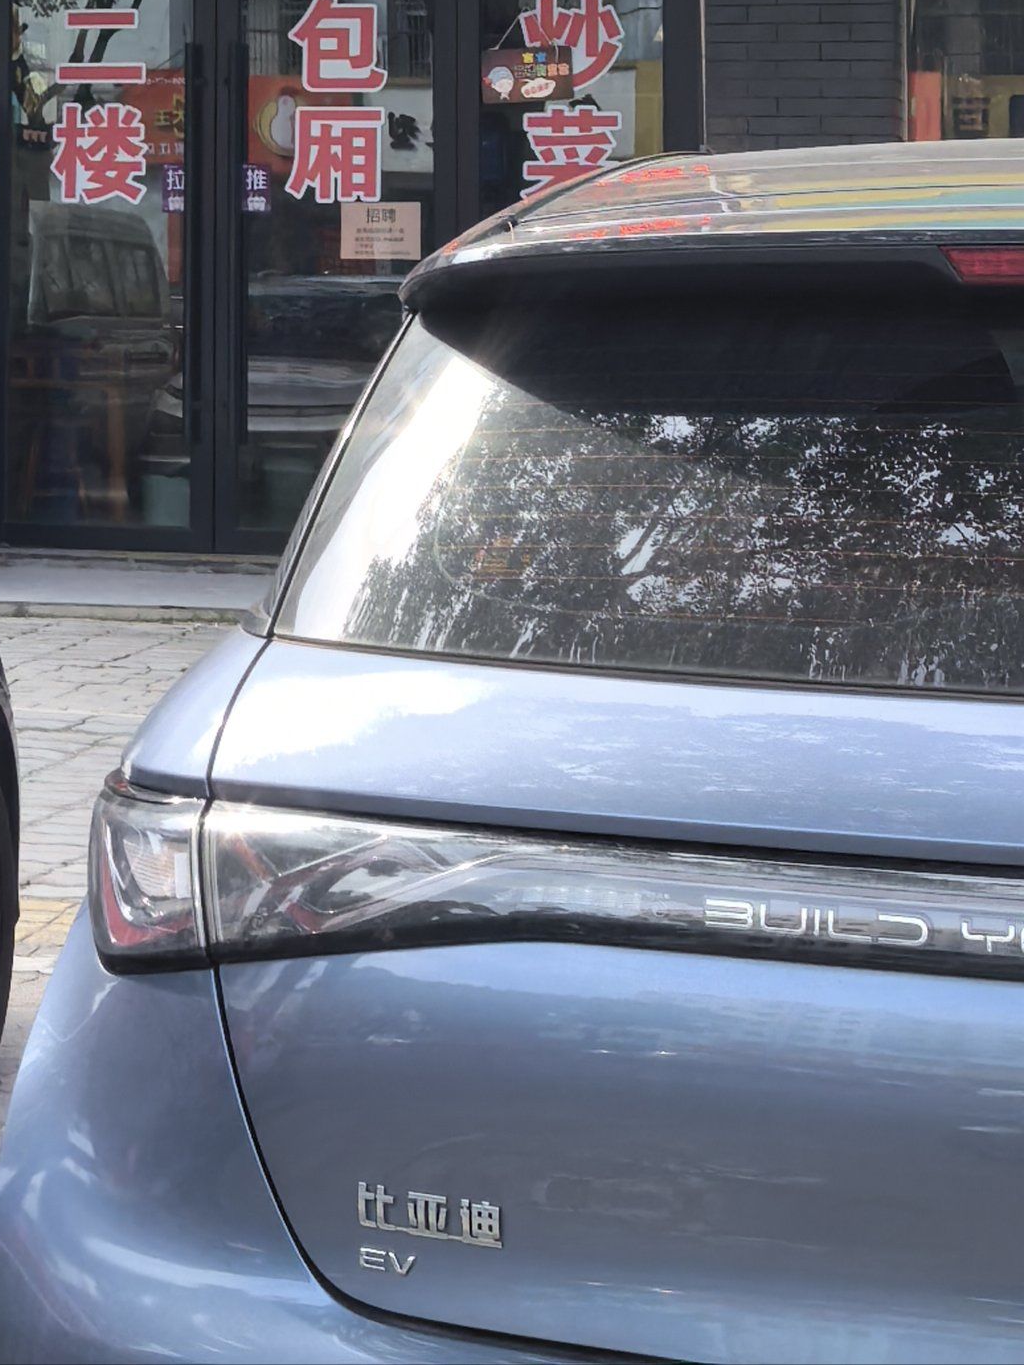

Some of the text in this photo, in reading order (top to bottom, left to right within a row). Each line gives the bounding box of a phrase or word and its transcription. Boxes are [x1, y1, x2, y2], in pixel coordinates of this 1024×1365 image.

[52, 7, 148, 205] 二楼
[166, 169, 184, 191] 拉
[245, 169, 268, 191] 推
[366, 207, 396, 224] 招聘
[704, 898, 1024, 953] BUILD Y
[357, 1181, 503, 1249] 比亚迪
[359, 1246, 416, 1276] EV
